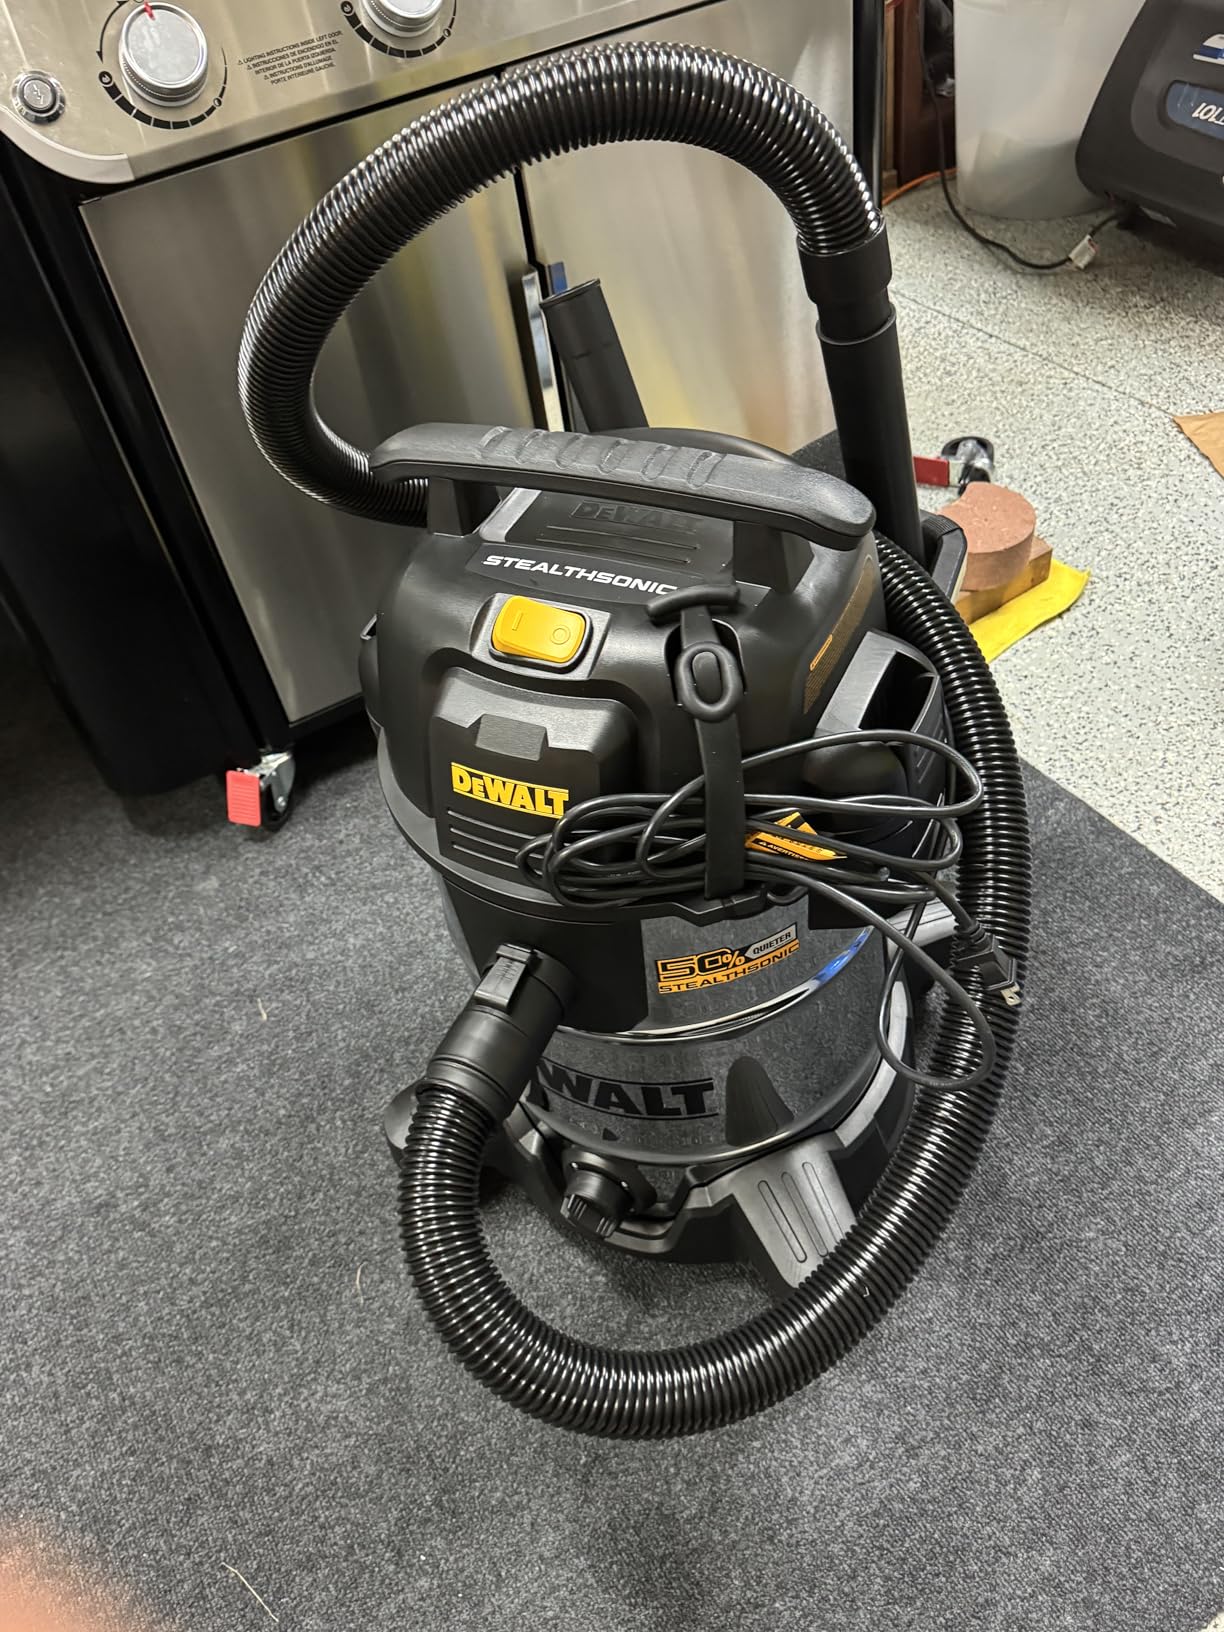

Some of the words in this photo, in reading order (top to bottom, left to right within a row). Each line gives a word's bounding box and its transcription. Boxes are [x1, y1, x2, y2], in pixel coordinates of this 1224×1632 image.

[255, 64, 277, 74] INTERIOR
[292, 55, 310, 64] PUERTA
[266, 43, 300, 56] INSTRUCTIONS
[300, 38, 315, 46] INSIDE
[269, 64, 303, 78] INSTRUCTIONS
[271, 77, 286, 85] PORTE
[483, 555, 678, 595] STEALTHSONIC
[451, 762, 569, 819] DEWALT
[657, 947, 745, 981] 50%
[753, 931, 792, 955] QUIETER
[659, 944, 800, 993] STEALTHSONIC
[537, 1060, 714, 1116] WALT
